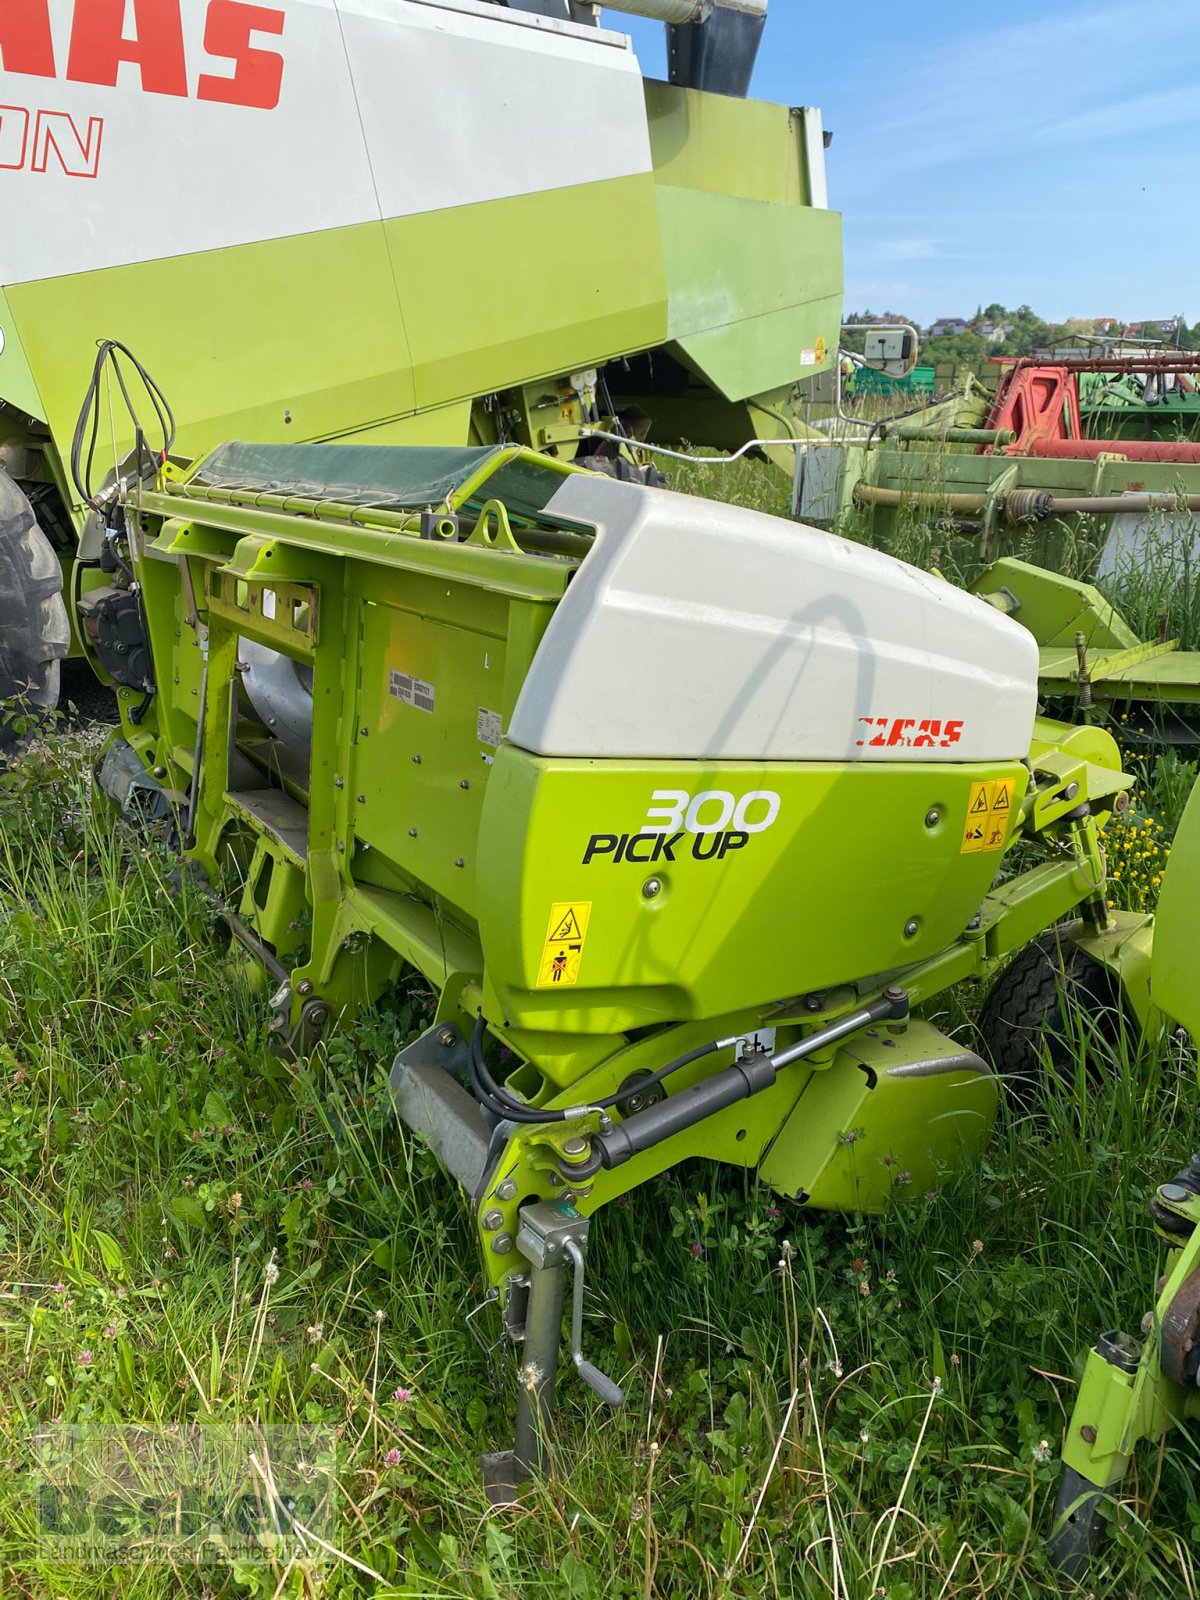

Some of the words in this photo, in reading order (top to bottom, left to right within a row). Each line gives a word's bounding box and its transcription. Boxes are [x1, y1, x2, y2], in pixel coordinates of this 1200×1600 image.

[640, 789, 782, 835] 300
[581, 832, 685, 865] PICK
[692, 831, 750, 861] UP
